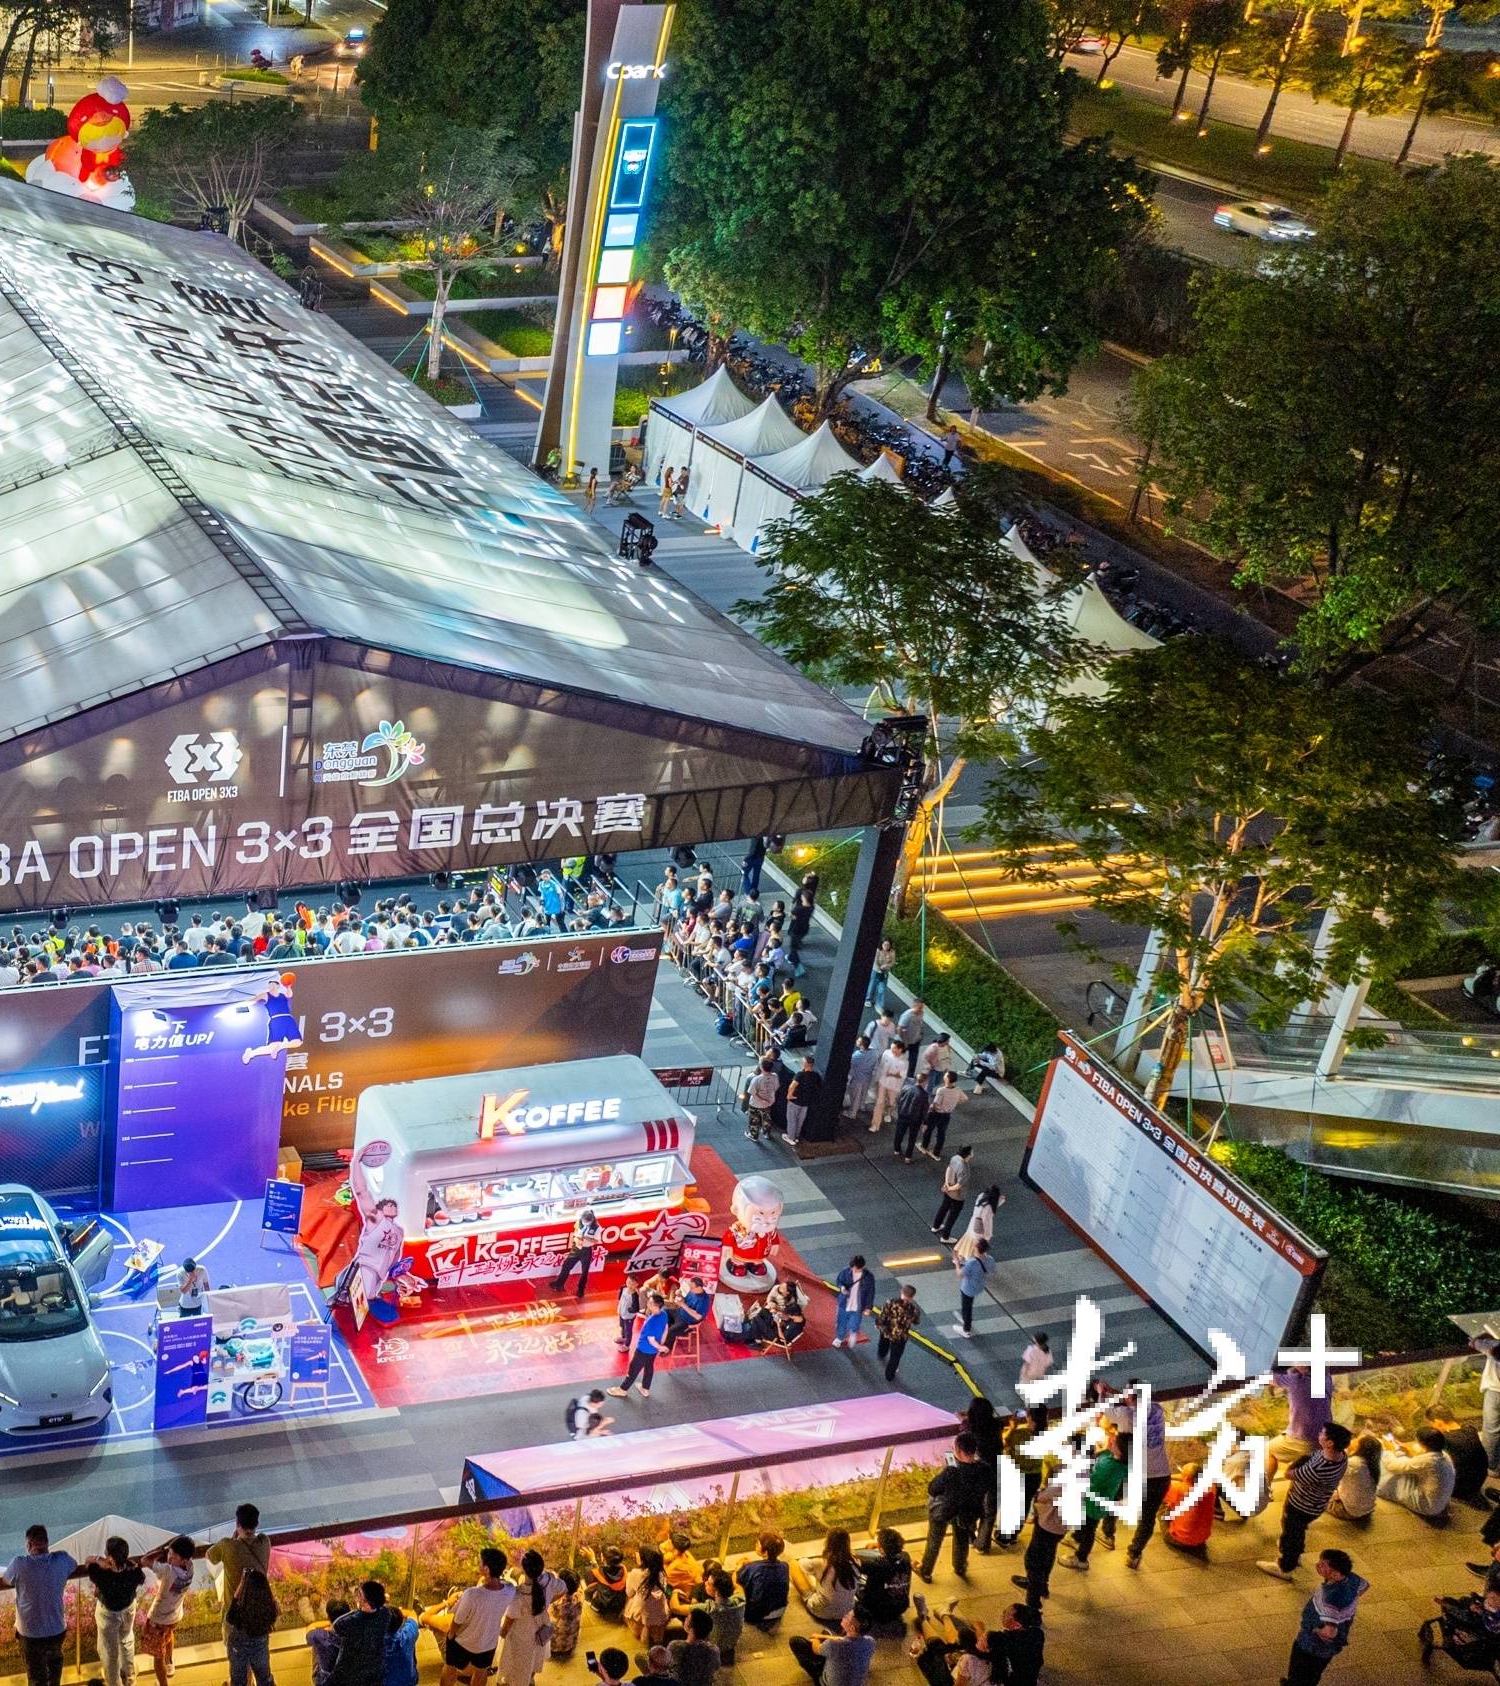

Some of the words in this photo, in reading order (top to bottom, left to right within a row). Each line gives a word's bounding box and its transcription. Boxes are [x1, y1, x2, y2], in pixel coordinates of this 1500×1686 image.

[323, 742, 358, 759] 东莞
[314, 756, 377, 772] Dongguan
[167, 789, 190, 802] FIBA
[192, 788, 218, 801] OPEN
[219, 786, 238, 798] 3X3
[69, 825, 216, 879] OPEN
[347, 792, 646, 855] 全国总决赛
[1092, 1071, 1116, 1099] FIBA
[1116, 1095, 1144, 1123] OPEN
[628, 1257, 663, 1271] KFC
